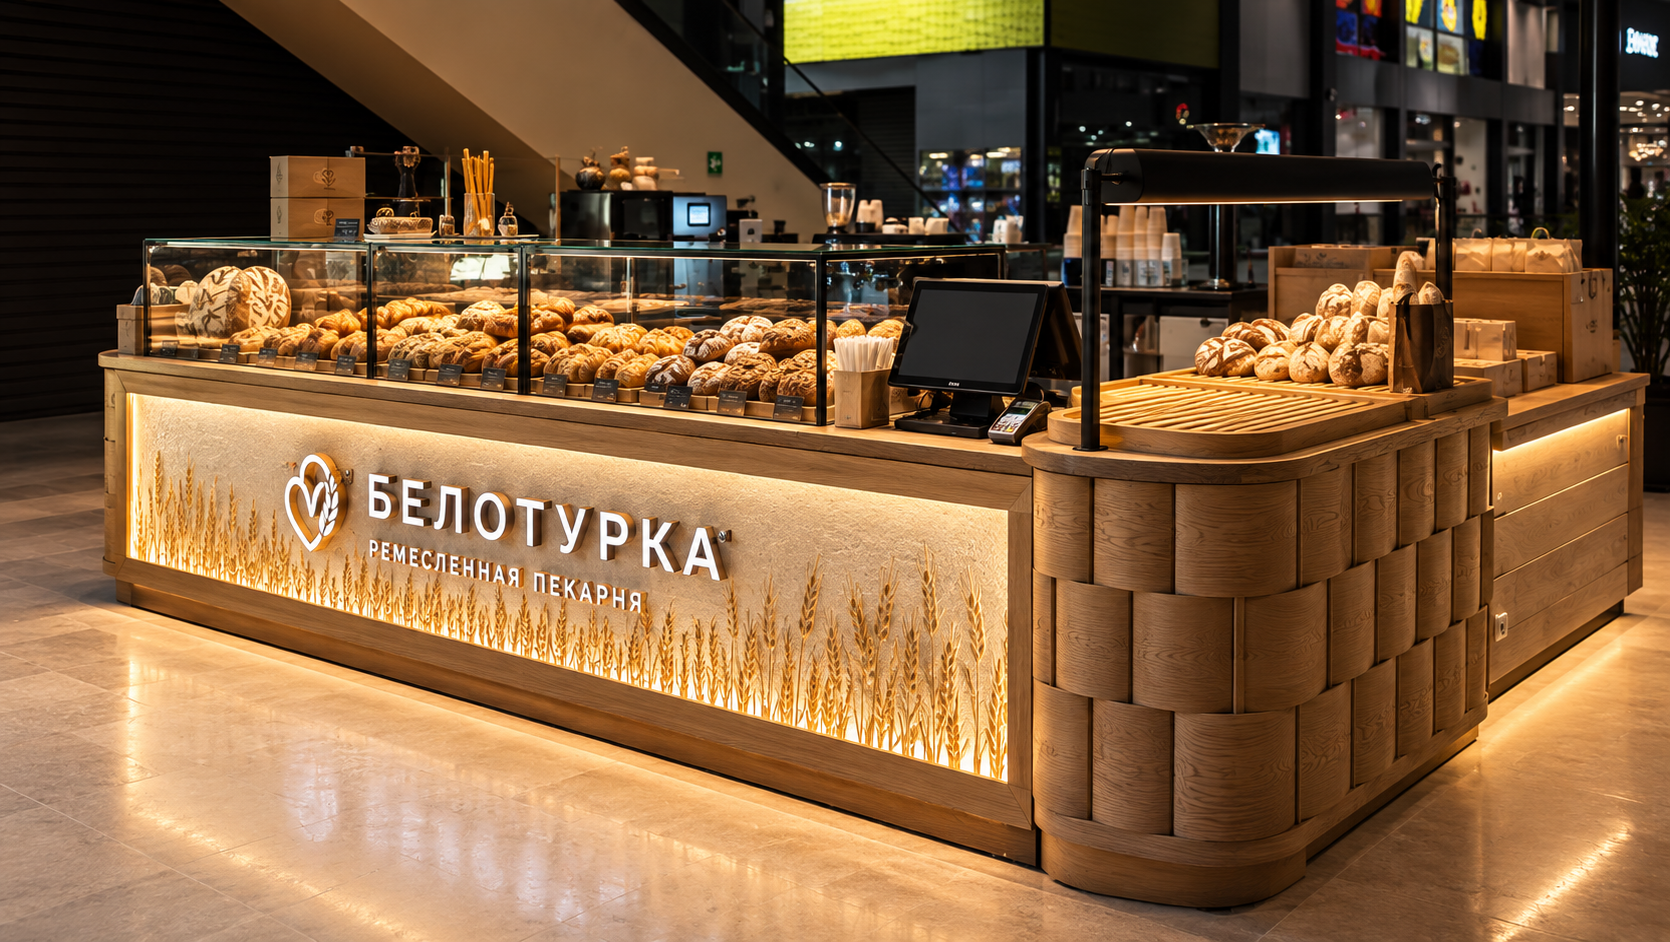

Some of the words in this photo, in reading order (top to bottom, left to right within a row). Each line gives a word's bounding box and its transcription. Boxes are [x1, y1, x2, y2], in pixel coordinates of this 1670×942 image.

[367, 473, 727, 581] БЕЛОТУРКА
[369, 539, 523, 588] РЕМЕСЛЕННАЯ
[534, 571, 644, 613] ПЕКАРНЯ
